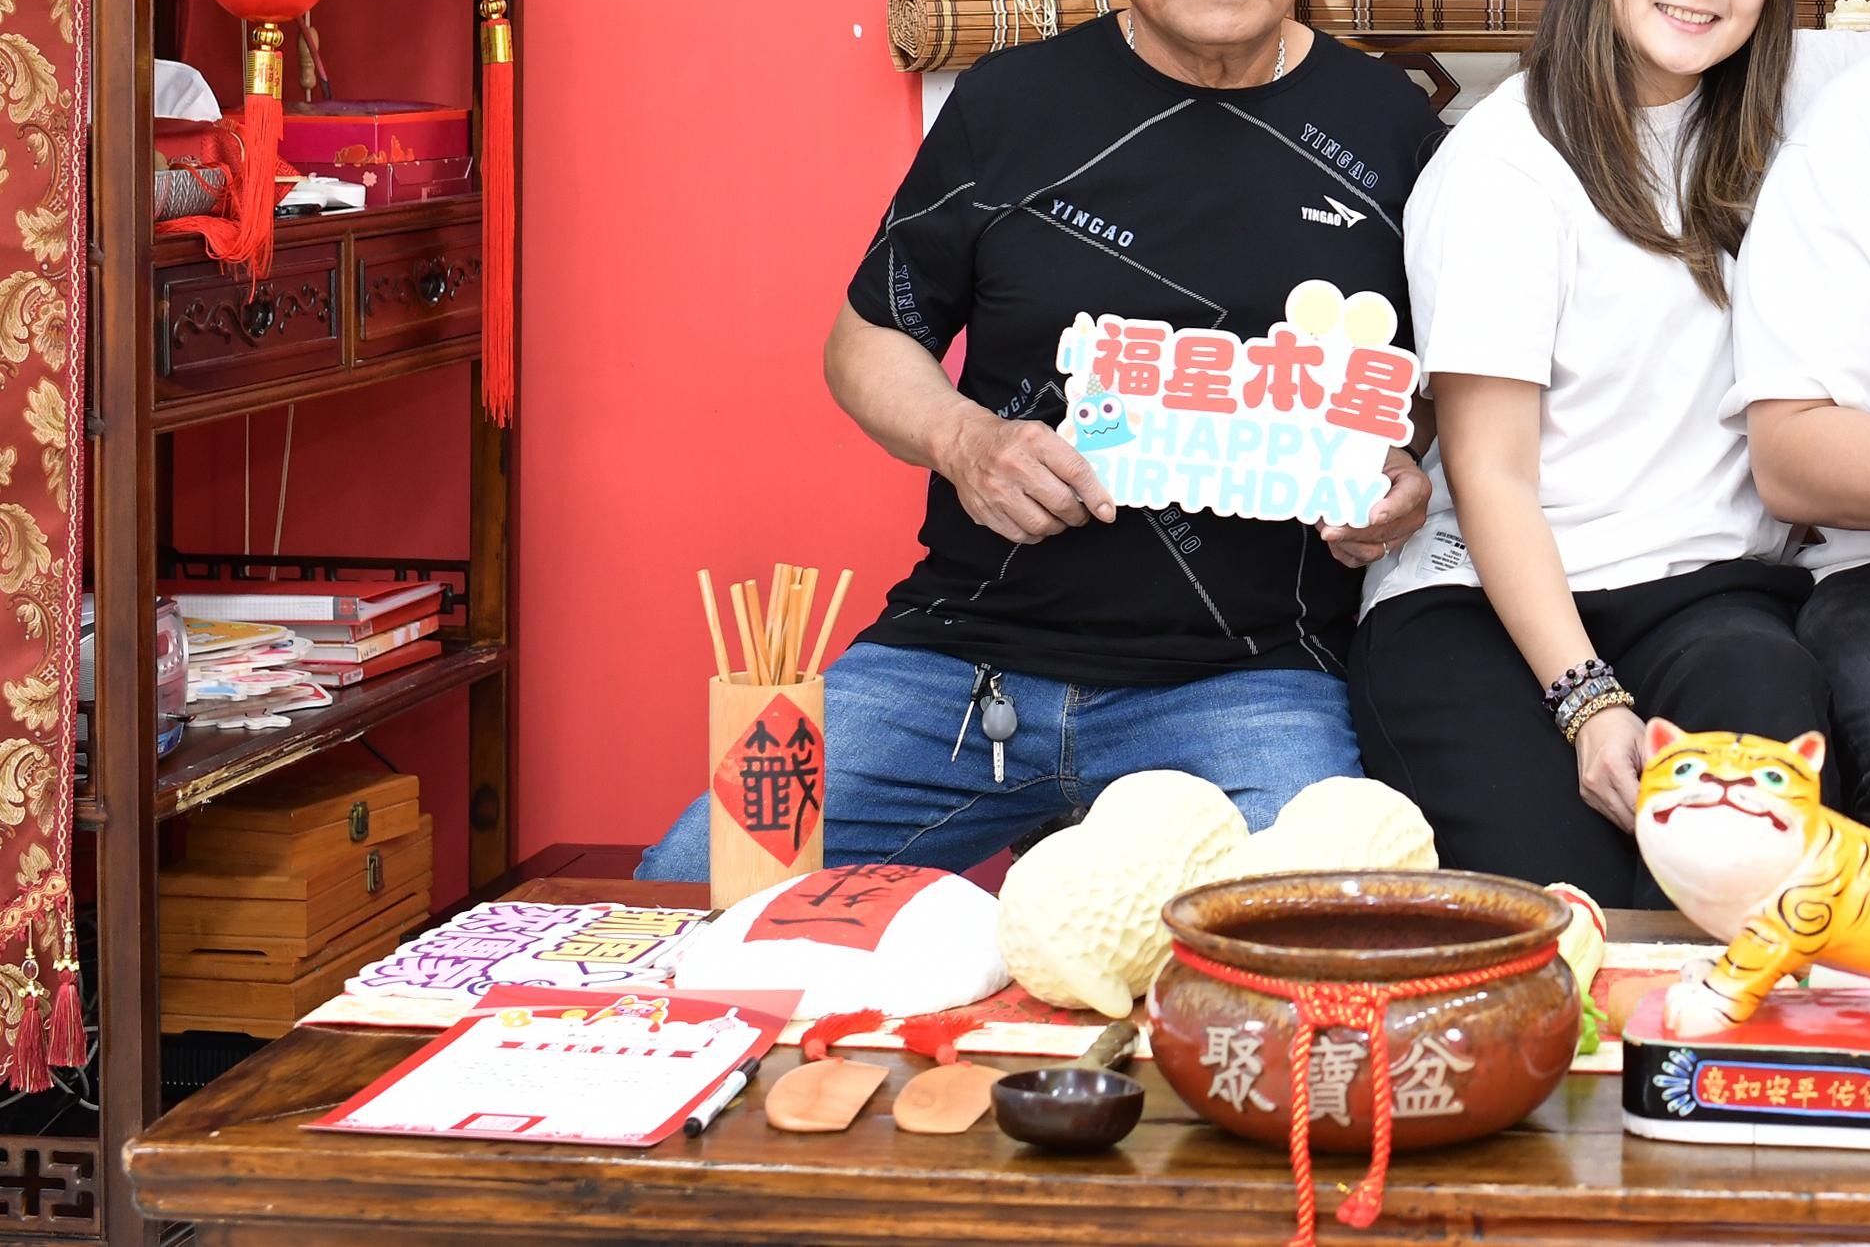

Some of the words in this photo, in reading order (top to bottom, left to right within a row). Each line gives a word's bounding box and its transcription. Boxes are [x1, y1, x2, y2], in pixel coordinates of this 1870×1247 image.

[1301, 123, 1380, 189] YINGAO
[1050, 199, 1135, 249] YINGAO
[1301, 206, 1342, 227] YINGAO
[1092, 321, 1414, 441] 福星本星
[1140, 411, 1350, 471] HAPPY
[362, 905, 582, 990] 來傳家
[532, 910, 702, 964] 抓周
[1199, 1026, 1476, 1127] 聚寶盆
